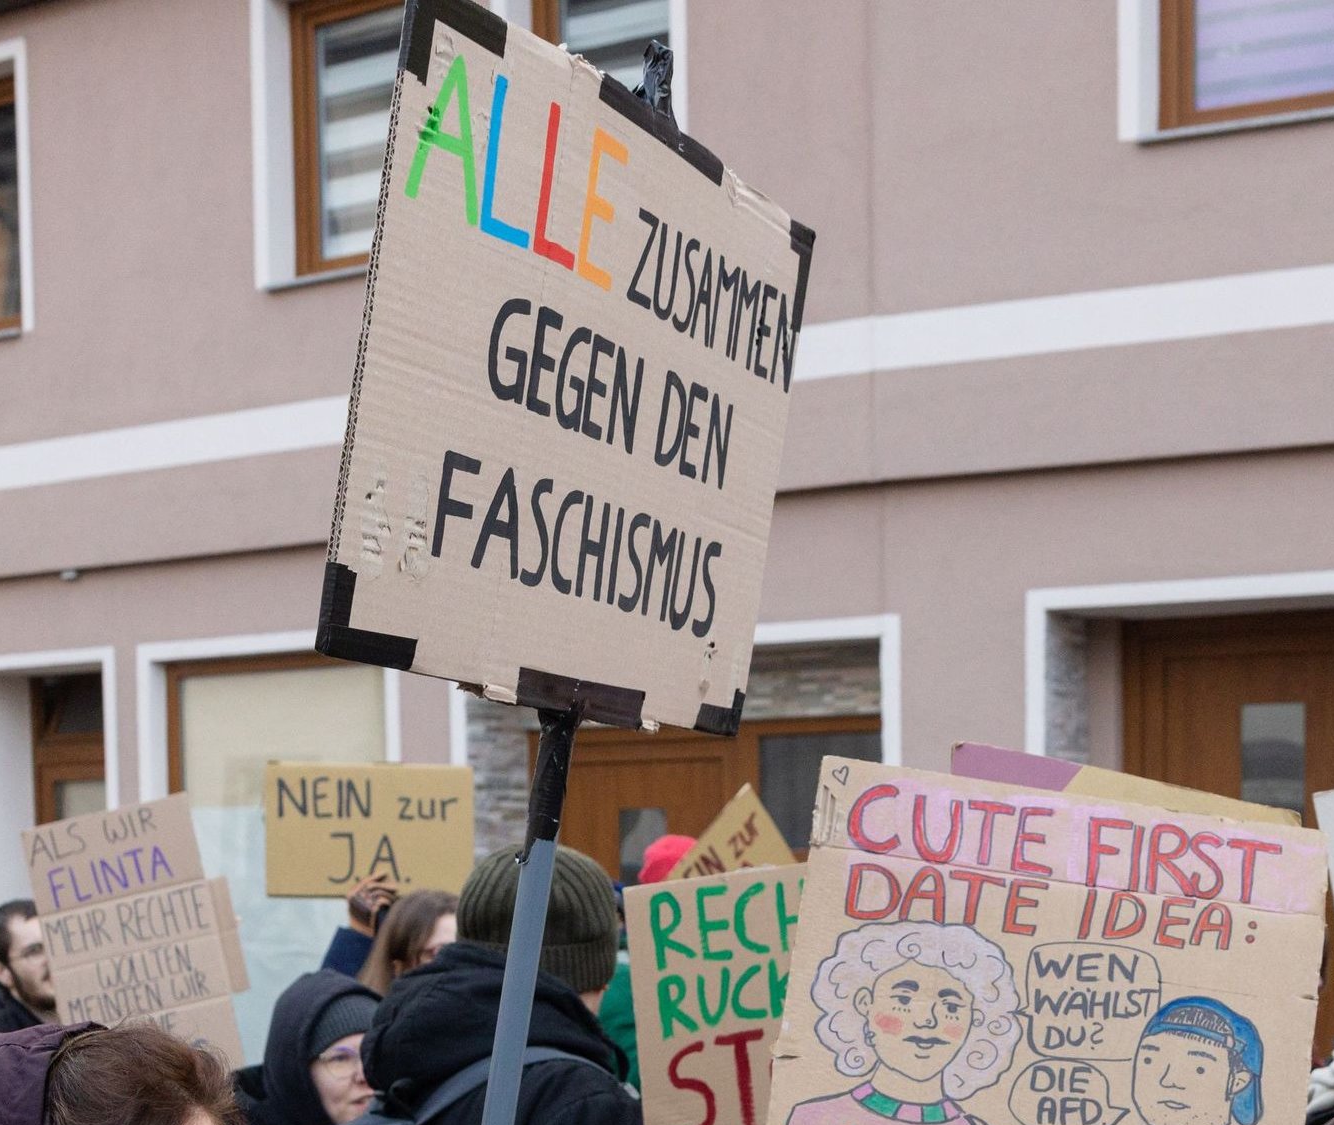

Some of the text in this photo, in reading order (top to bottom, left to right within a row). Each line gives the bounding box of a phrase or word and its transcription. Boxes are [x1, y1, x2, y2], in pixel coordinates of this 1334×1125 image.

[404, 54, 797, 394] ALLE ZUSAMMEN
[488, 297, 734, 490] GEGEN DEN
[431, 449, 723, 638] FASCHISMUS
[277, 776, 459, 820] NEIN zur
[30, 807, 157, 867] ALS WIR
[328, 832, 411, 884] J.A.
[848, 783, 1283, 903] CUTE FIRST
[47, 845, 174, 909] FLINTA
[844, 863, 1259, 950] DATE IDEA:
[44, 884, 211, 957] MEHR RECHTE
[650, 879, 805, 970] RECH
[171, 969, 210, 1001] WIR
[1033, 952, 1139, 983] WEN
[1034, 987, 1159, 1020] WÄHLST
[1043, 1022, 1104, 1050] DU?
[1030, 1065, 1093, 1093] DIE
